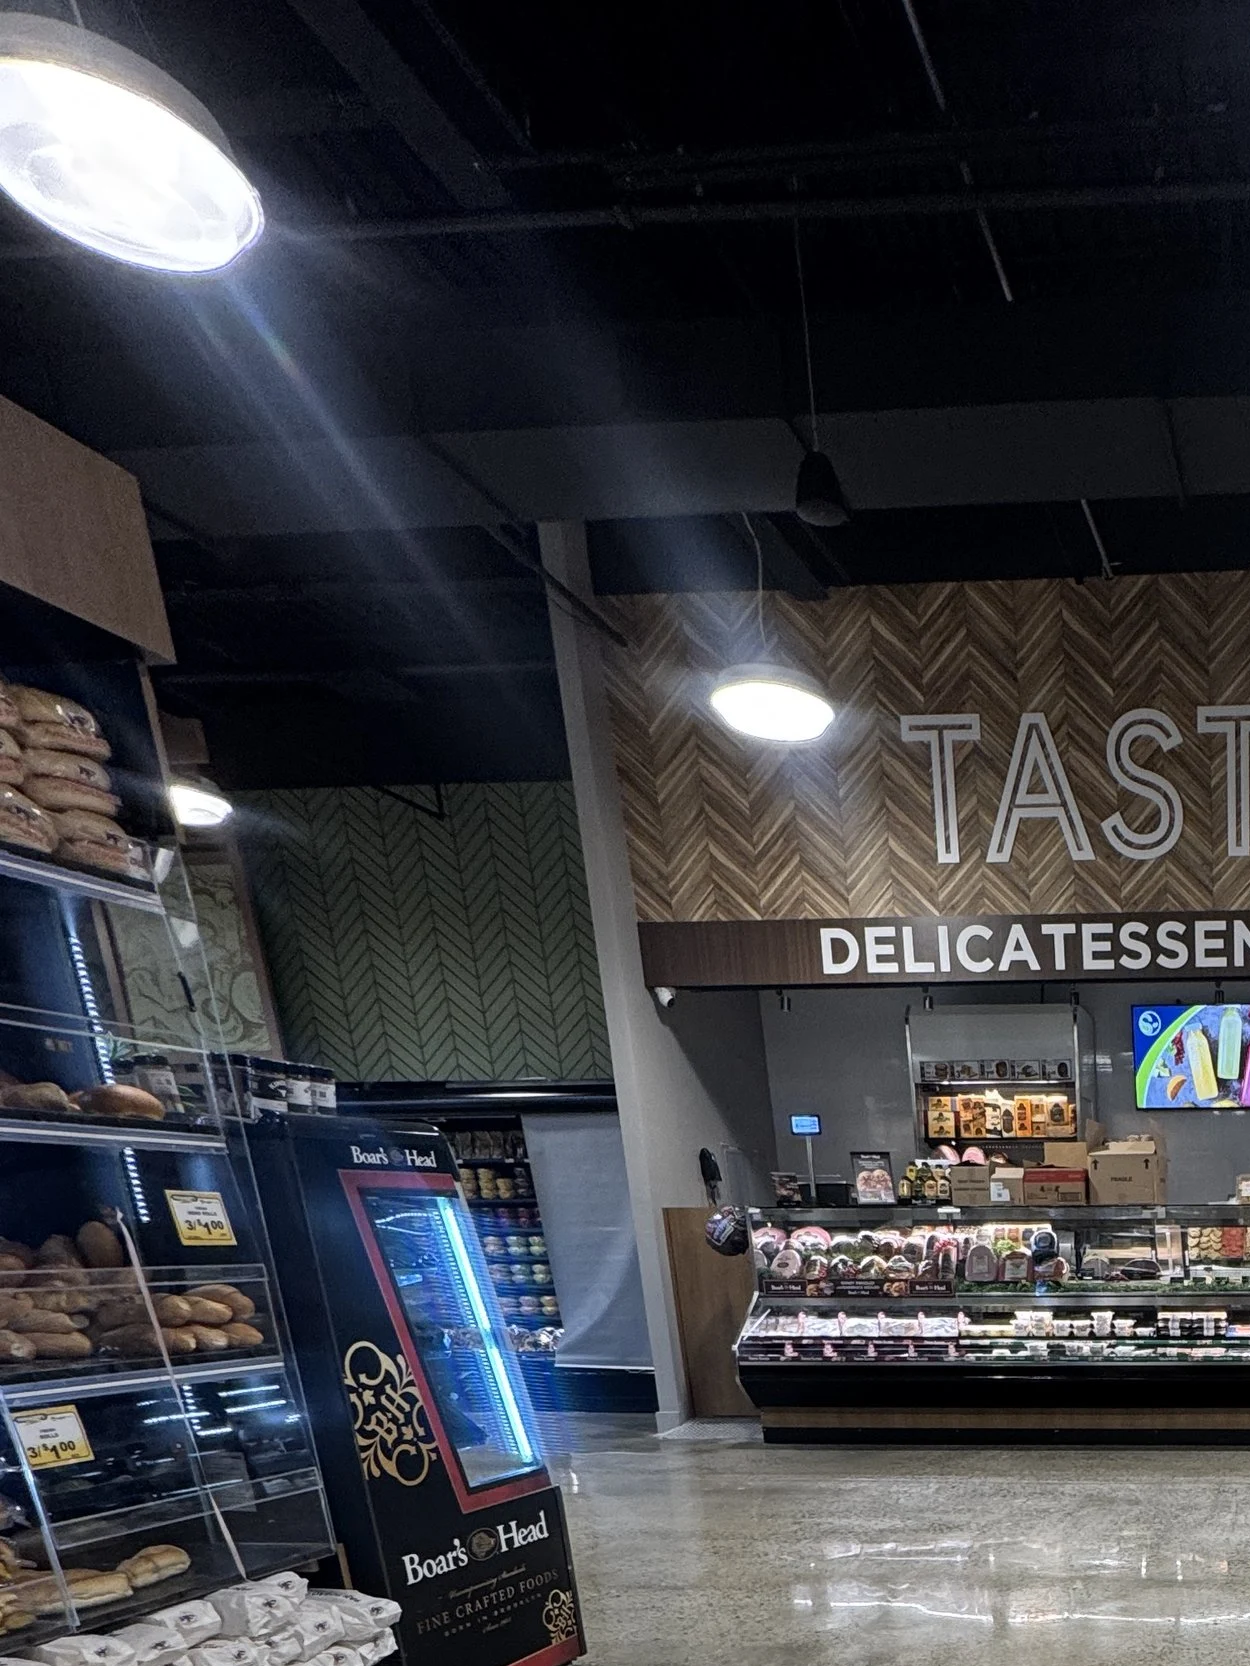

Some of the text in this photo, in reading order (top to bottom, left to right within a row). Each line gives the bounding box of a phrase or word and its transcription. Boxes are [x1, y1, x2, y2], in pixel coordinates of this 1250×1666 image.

[350, 1145, 437, 1168] Boar's Head
[402, 1538, 468, 1586] Boar's
[497, 1510, 549, 1553] Head
[417, 1611, 450, 1635] FINE
[456, 1586, 515, 1619] CRAFTED
[519, 1568, 559, 1593] FOODS
